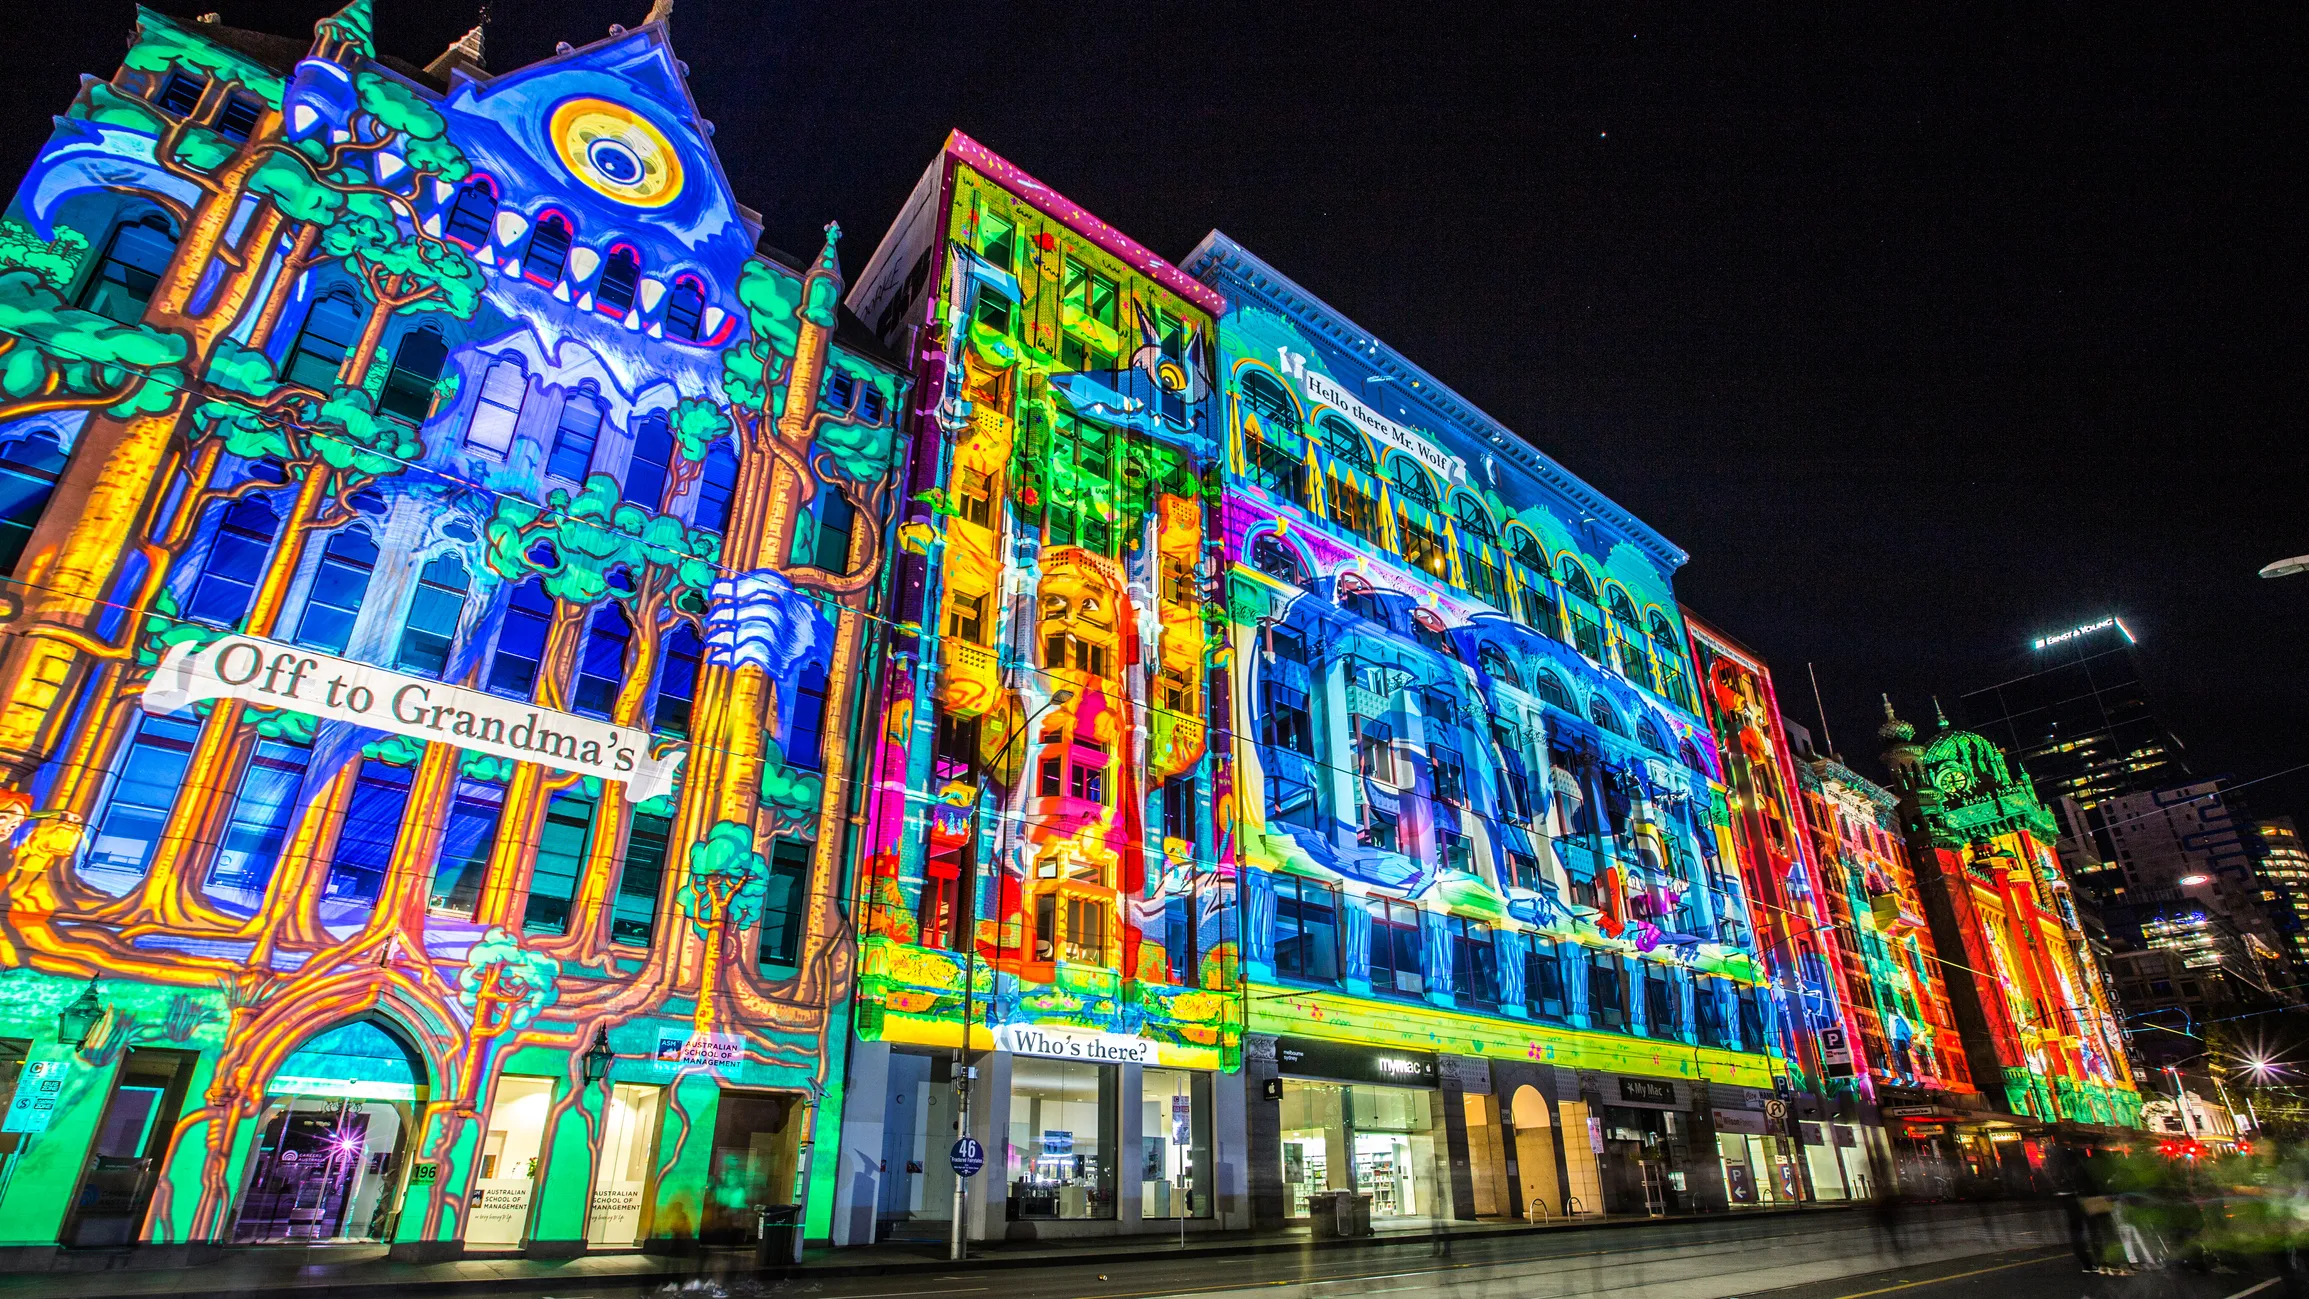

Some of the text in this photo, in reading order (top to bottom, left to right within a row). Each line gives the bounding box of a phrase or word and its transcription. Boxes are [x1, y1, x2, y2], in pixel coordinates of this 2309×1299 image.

[1308, 375, 1447, 470] Hello there Mr. Wolf
[2046, 618, 2113, 645] ERNST & YOUNG
[214, 642, 635, 772] Off to Grandma's
[2101, 970, 2140, 1060] FORUM
[686, 1041, 738, 1051] AUSTRALIAN
[1014, 1030, 1147, 1061] Who's there?
[1827, 1033, 1839, 1046] P
[684, 1049, 719, 1058] SCHOOL
[683, 1057, 741, 1067] MANAGEMENT
[1379, 1057, 1421, 1075] mymac
[1634, 1082, 1663, 1098] My Mac
[1777, 1078, 1786, 1090] P
[958, 1139, 976, 1158] 46
[415, 1166, 437, 1179] 196
[1732, 1169, 1742, 1182] P
